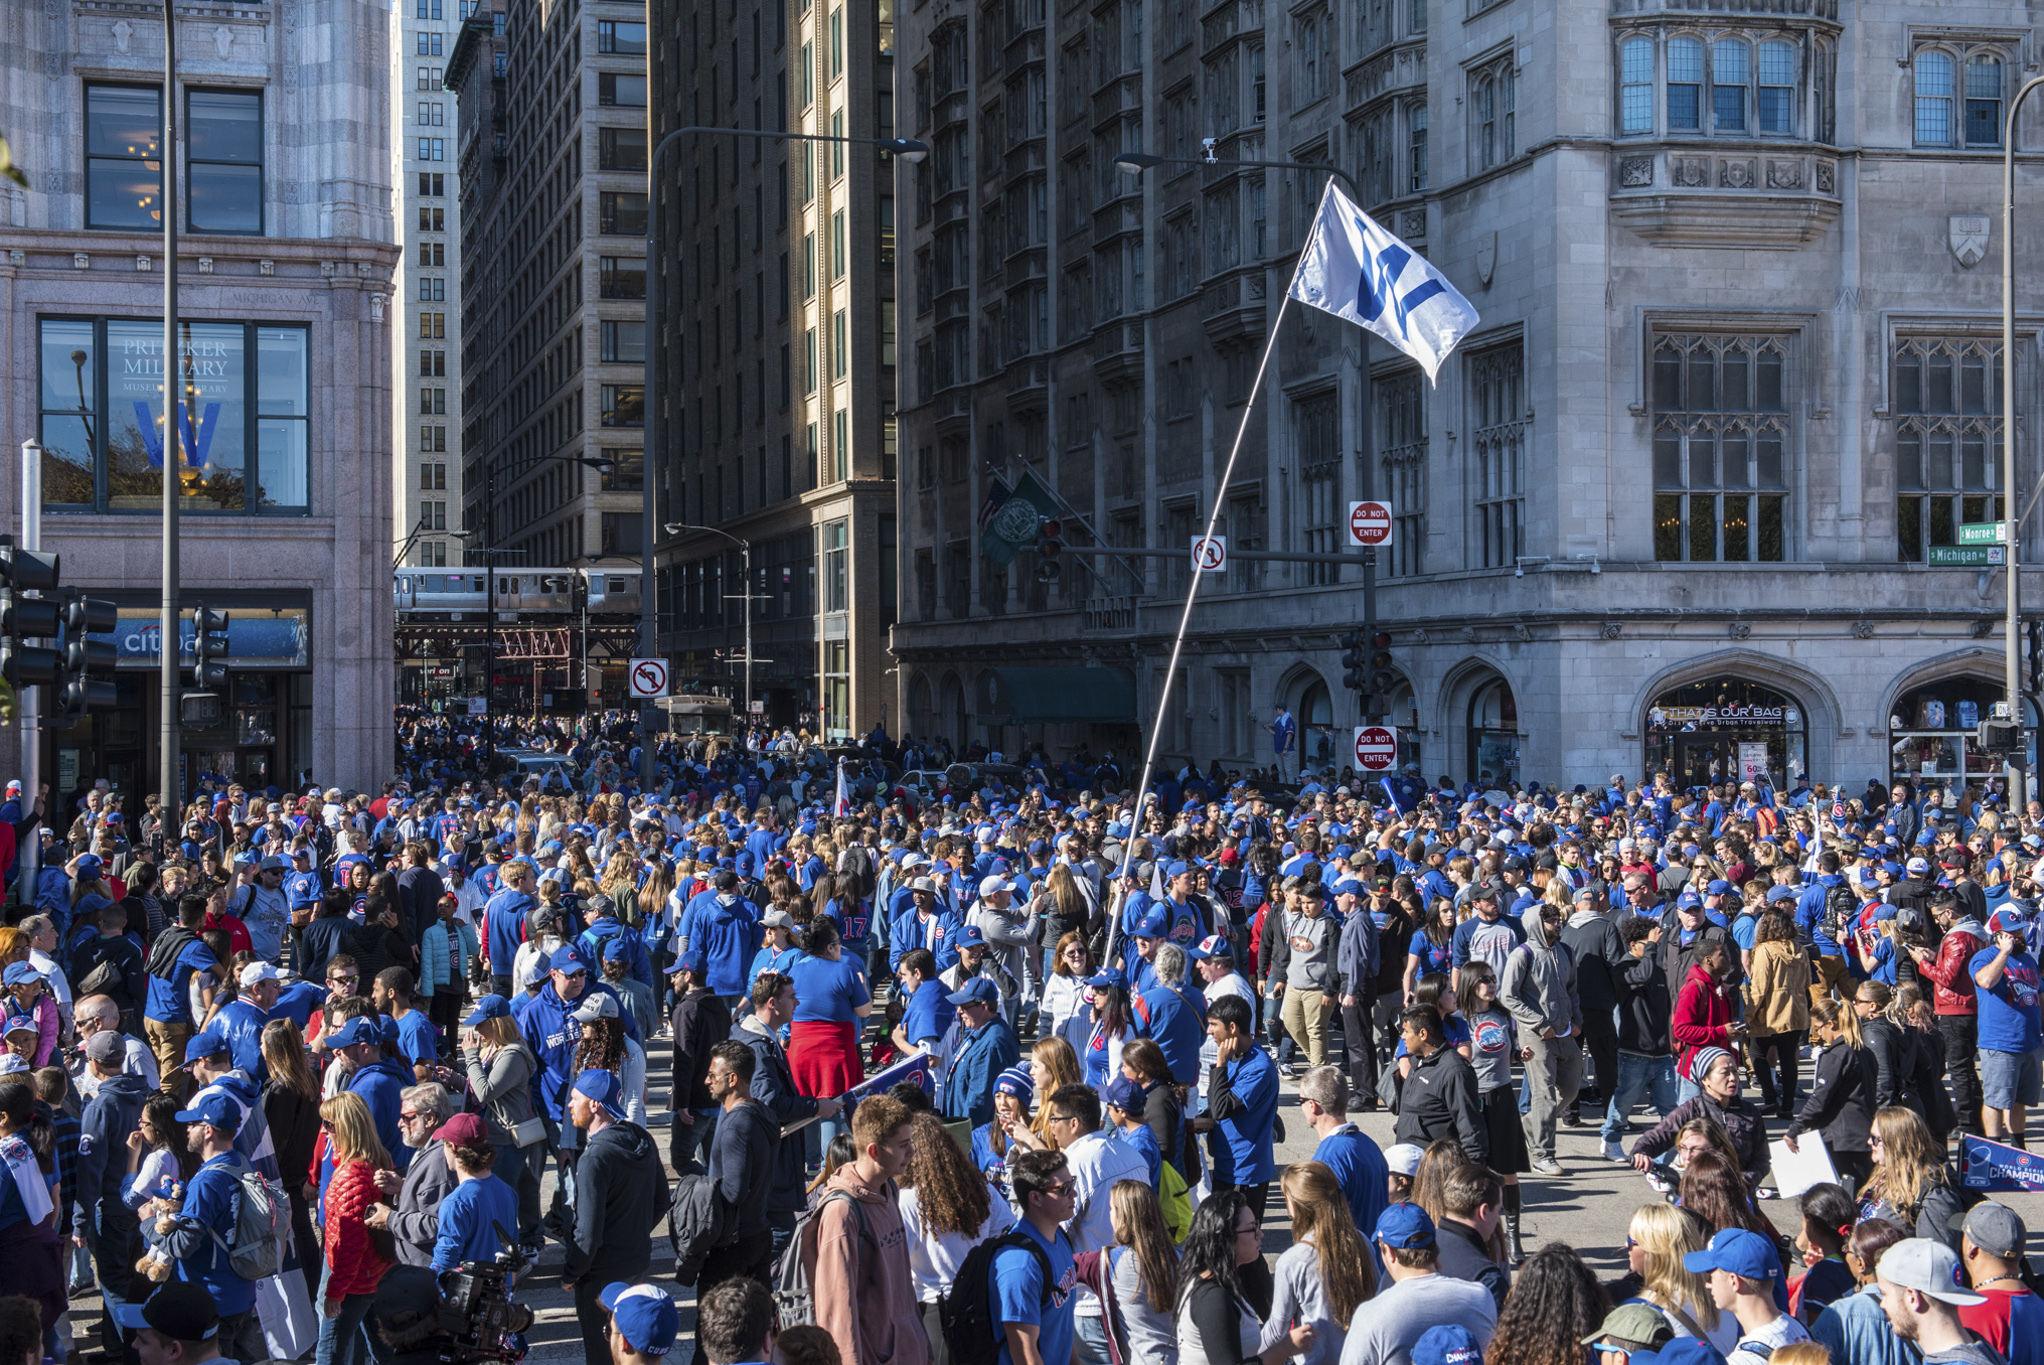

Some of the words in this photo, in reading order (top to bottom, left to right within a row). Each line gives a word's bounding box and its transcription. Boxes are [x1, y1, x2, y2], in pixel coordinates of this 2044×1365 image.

[1353, 216, 1447, 343] W
[233, 293, 292, 304] MICHIGAN
[123, 358, 228, 376] MILTARY
[123, 383, 164, 392] MUSEU
[133, 401, 222, 468] W
[1359, 529, 1383, 537] ENTER
[1965, 528, 1990, 540] Monroe
[1937, 549, 1978, 564] Michigan
[1670, 707, 1717, 717] THAT'S
[1721, 707, 1749, 717] OUR
[1754, 707, 1782, 717] BAG
[1998, 705, 2008, 715] ON
[1361, 735, 1372, 743] DO
[1375, 735, 1390, 743] NOT
[1364, 754, 1388, 762] ENTER
[1224, 890, 1244, 908] 12
[843, 917, 867, 940] 17
[568, 952, 577, 960] C
[648, 1346, 670, 1354] CUBS
